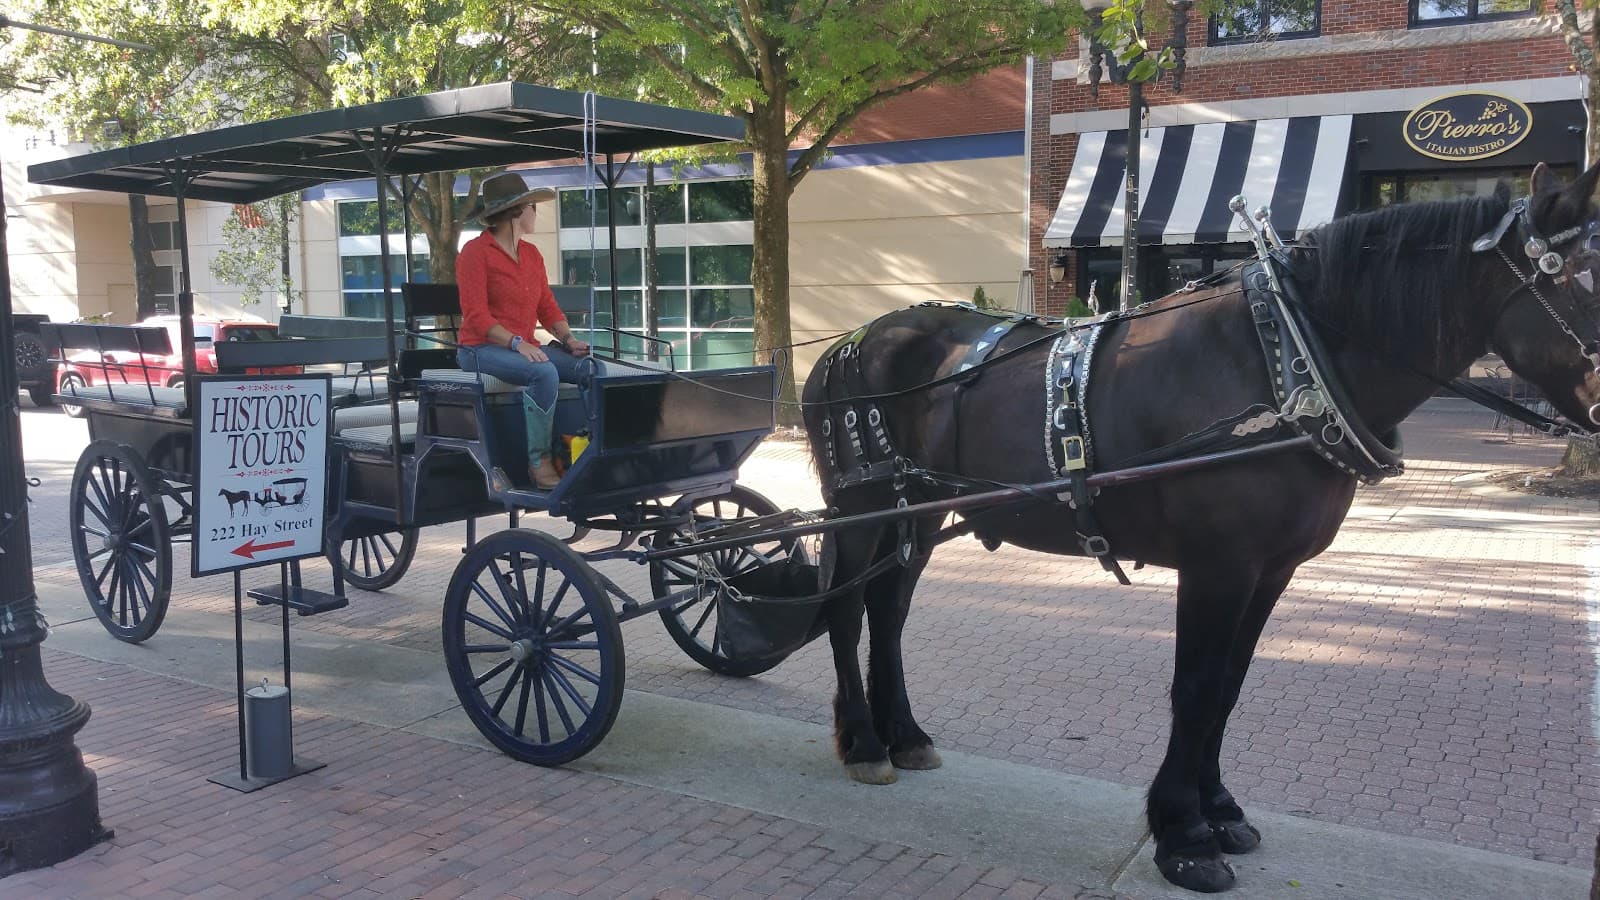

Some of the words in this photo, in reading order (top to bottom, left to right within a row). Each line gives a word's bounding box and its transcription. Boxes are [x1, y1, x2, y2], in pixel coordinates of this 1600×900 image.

[1414, 110, 1521, 140] Pierro's
[1426, 142, 1466, 155] ITALIAN
[1468, 139, 1505, 154] BISTRO
[210, 393, 322, 433] HISTORIC
[227, 429, 307, 469] TOURS
[210, 526, 235, 541] 222
[241, 522, 270, 538] Hay
[274, 517, 314, 532] Street
